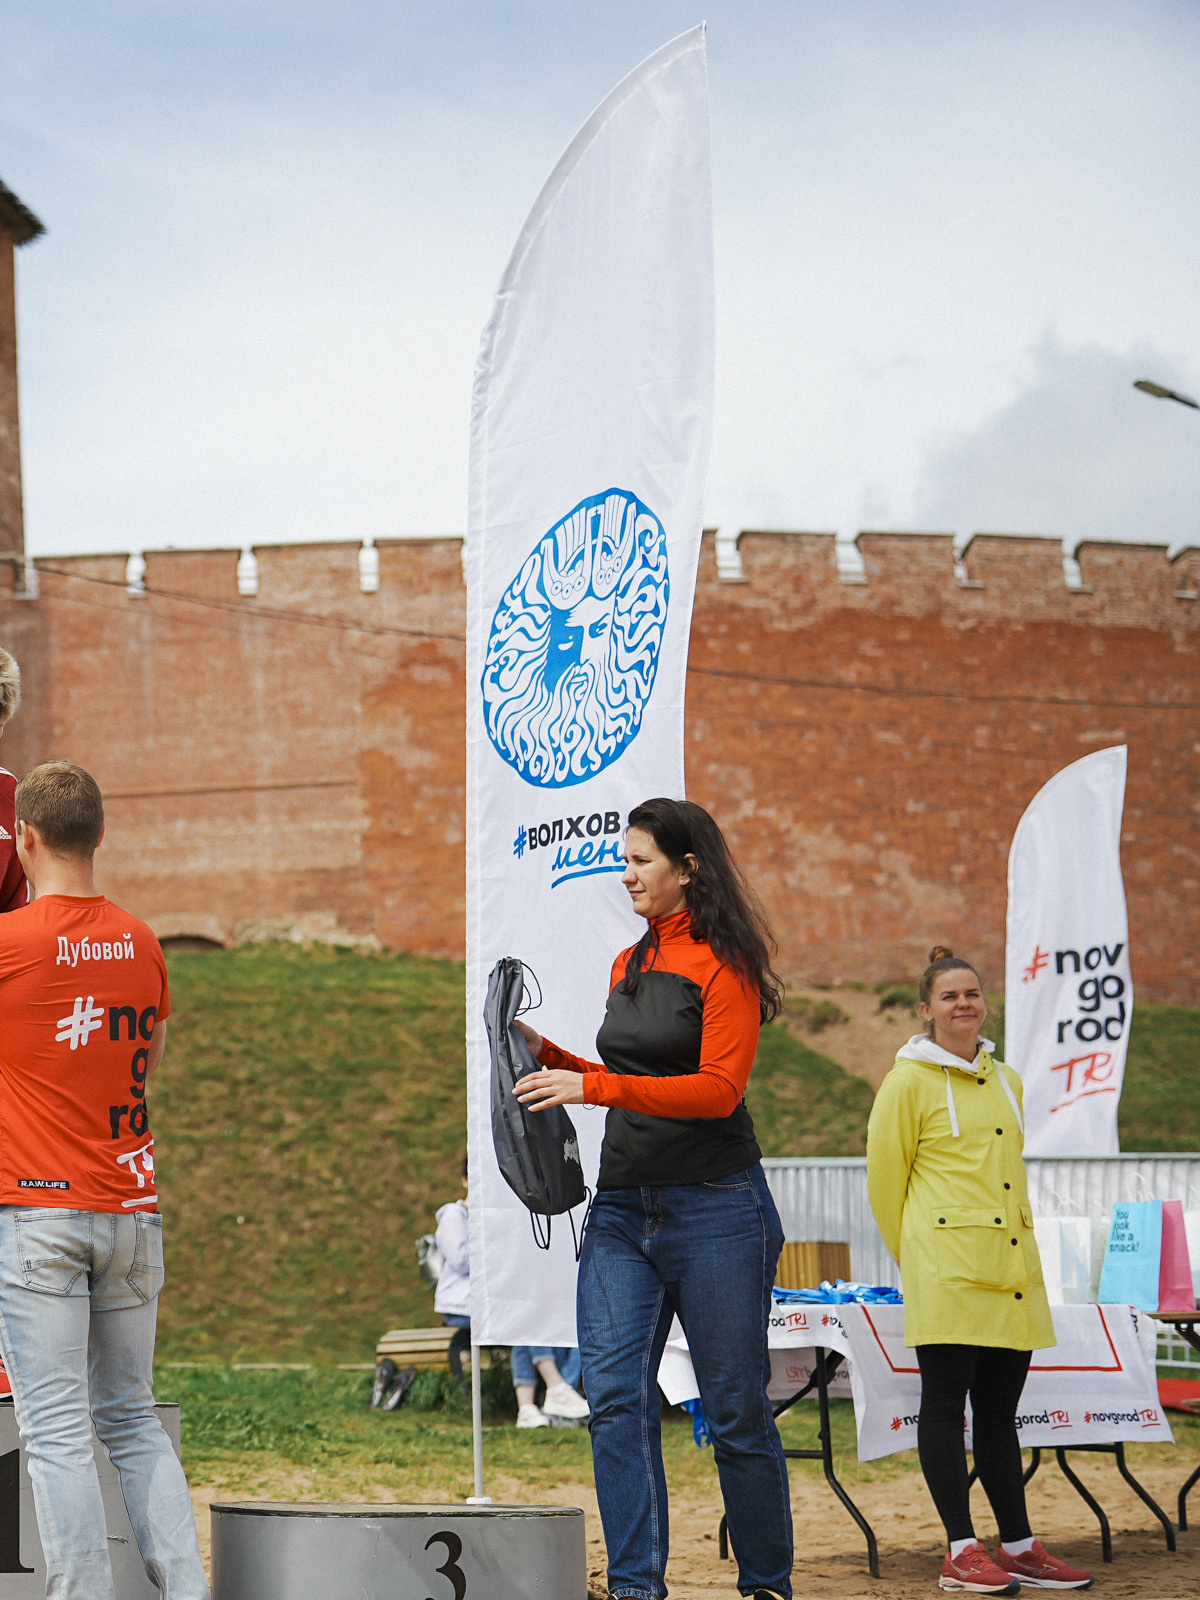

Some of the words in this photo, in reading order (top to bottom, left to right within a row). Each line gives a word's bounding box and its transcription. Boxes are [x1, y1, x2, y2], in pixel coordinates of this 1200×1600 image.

[513, 811, 621, 860] #ВОЛХОВ
[551, 839, 625, 872] мен
[56, 932, 135, 968] Дубовой
[1021, 943, 1125, 984] #nov
[1078, 975, 1125, 1012] go
[54, 995, 157, 1051] #no
[1057, 1001, 1126, 1043] rod
[129, 1047, 150, 1099] g
[109, 1097, 149, 1140] ro
[1109, 1241, 1139, 1252] snack!
[424, 1530, 467, 1600] 3
